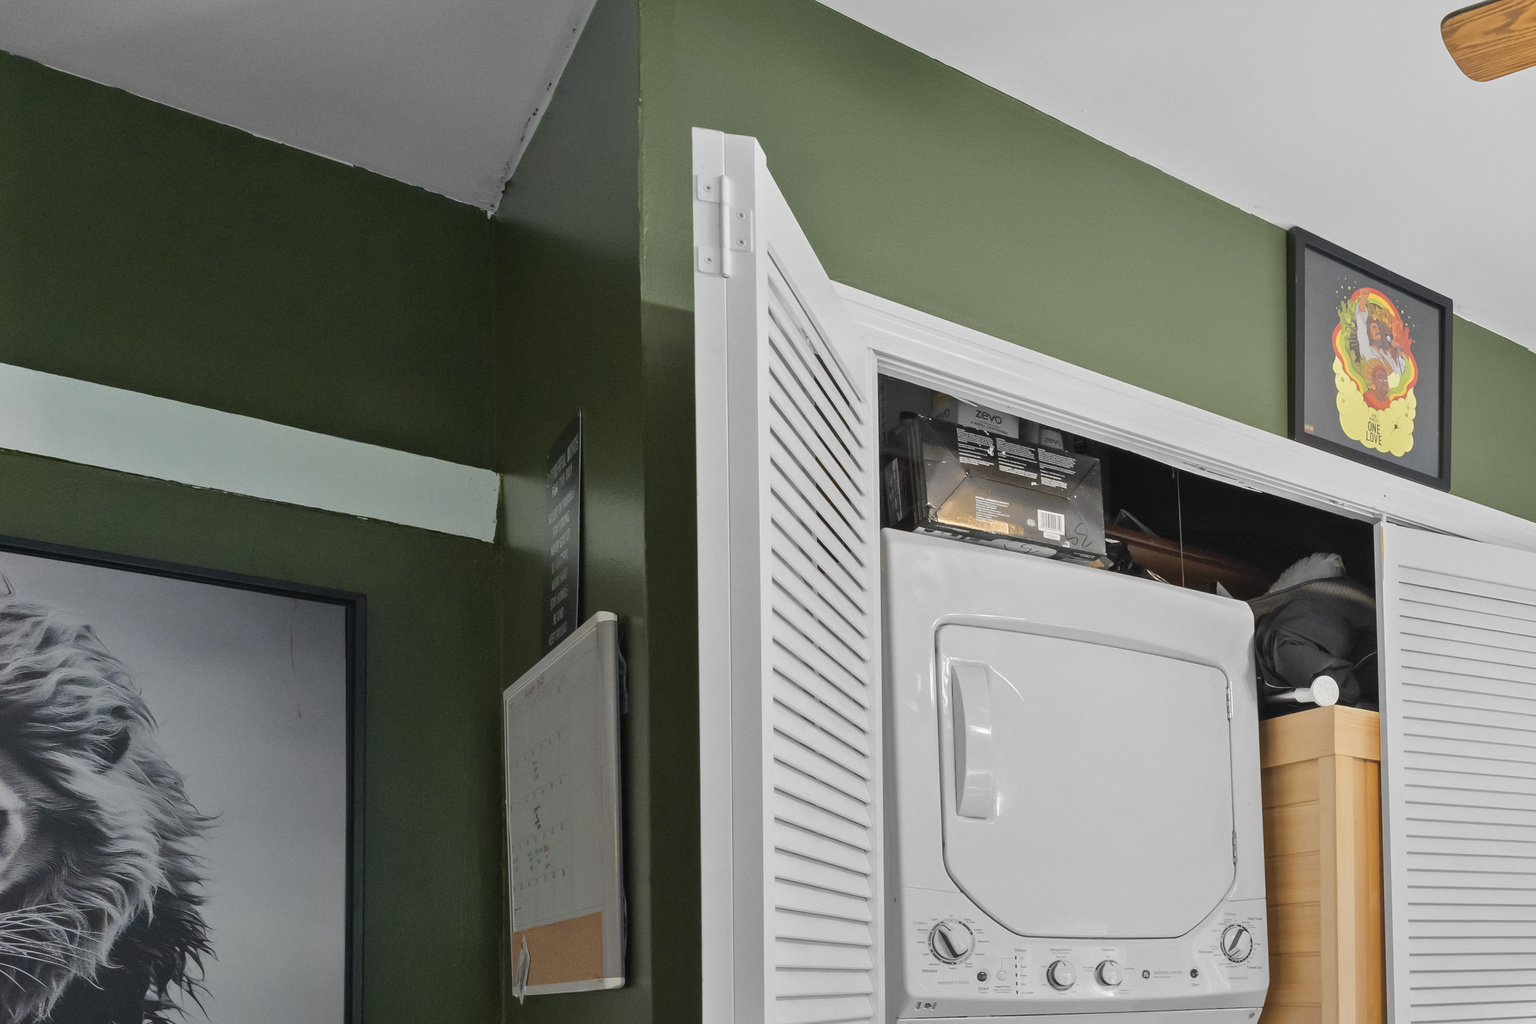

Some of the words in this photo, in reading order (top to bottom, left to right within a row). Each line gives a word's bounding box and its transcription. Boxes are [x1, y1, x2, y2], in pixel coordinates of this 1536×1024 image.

[975, 409, 1003, 425] zevo
[1368, 421, 1380, 434] ONE
[1366, 430, 1382, 446] LOVE
